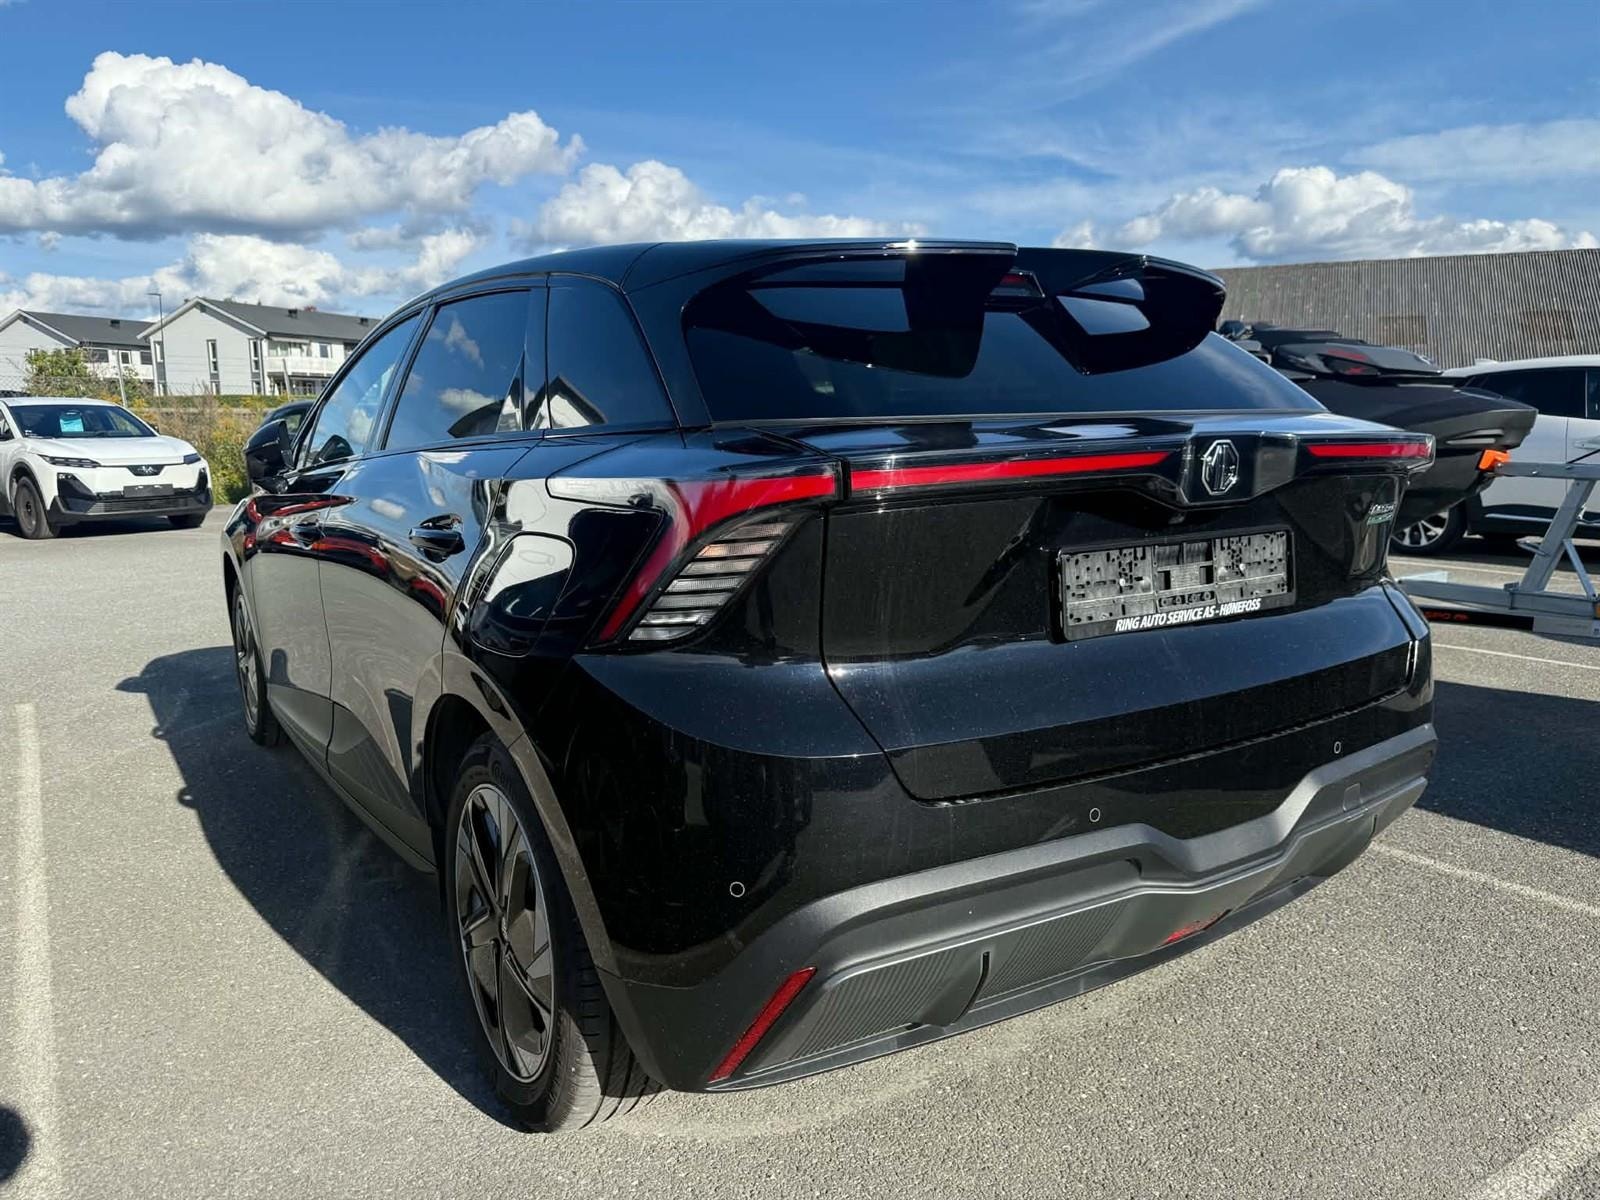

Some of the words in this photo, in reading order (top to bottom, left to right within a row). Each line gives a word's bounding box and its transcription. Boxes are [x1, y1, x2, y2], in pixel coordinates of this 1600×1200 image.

[1115, 616, 1141, 632] RING
[1140, 613, 1167, 629] AUTO
[1166, 606, 1204, 625] SERVICE
[1202, 605, 1216, 619] AS
[1219, 598, 1262, 616] HØNEFOSS
